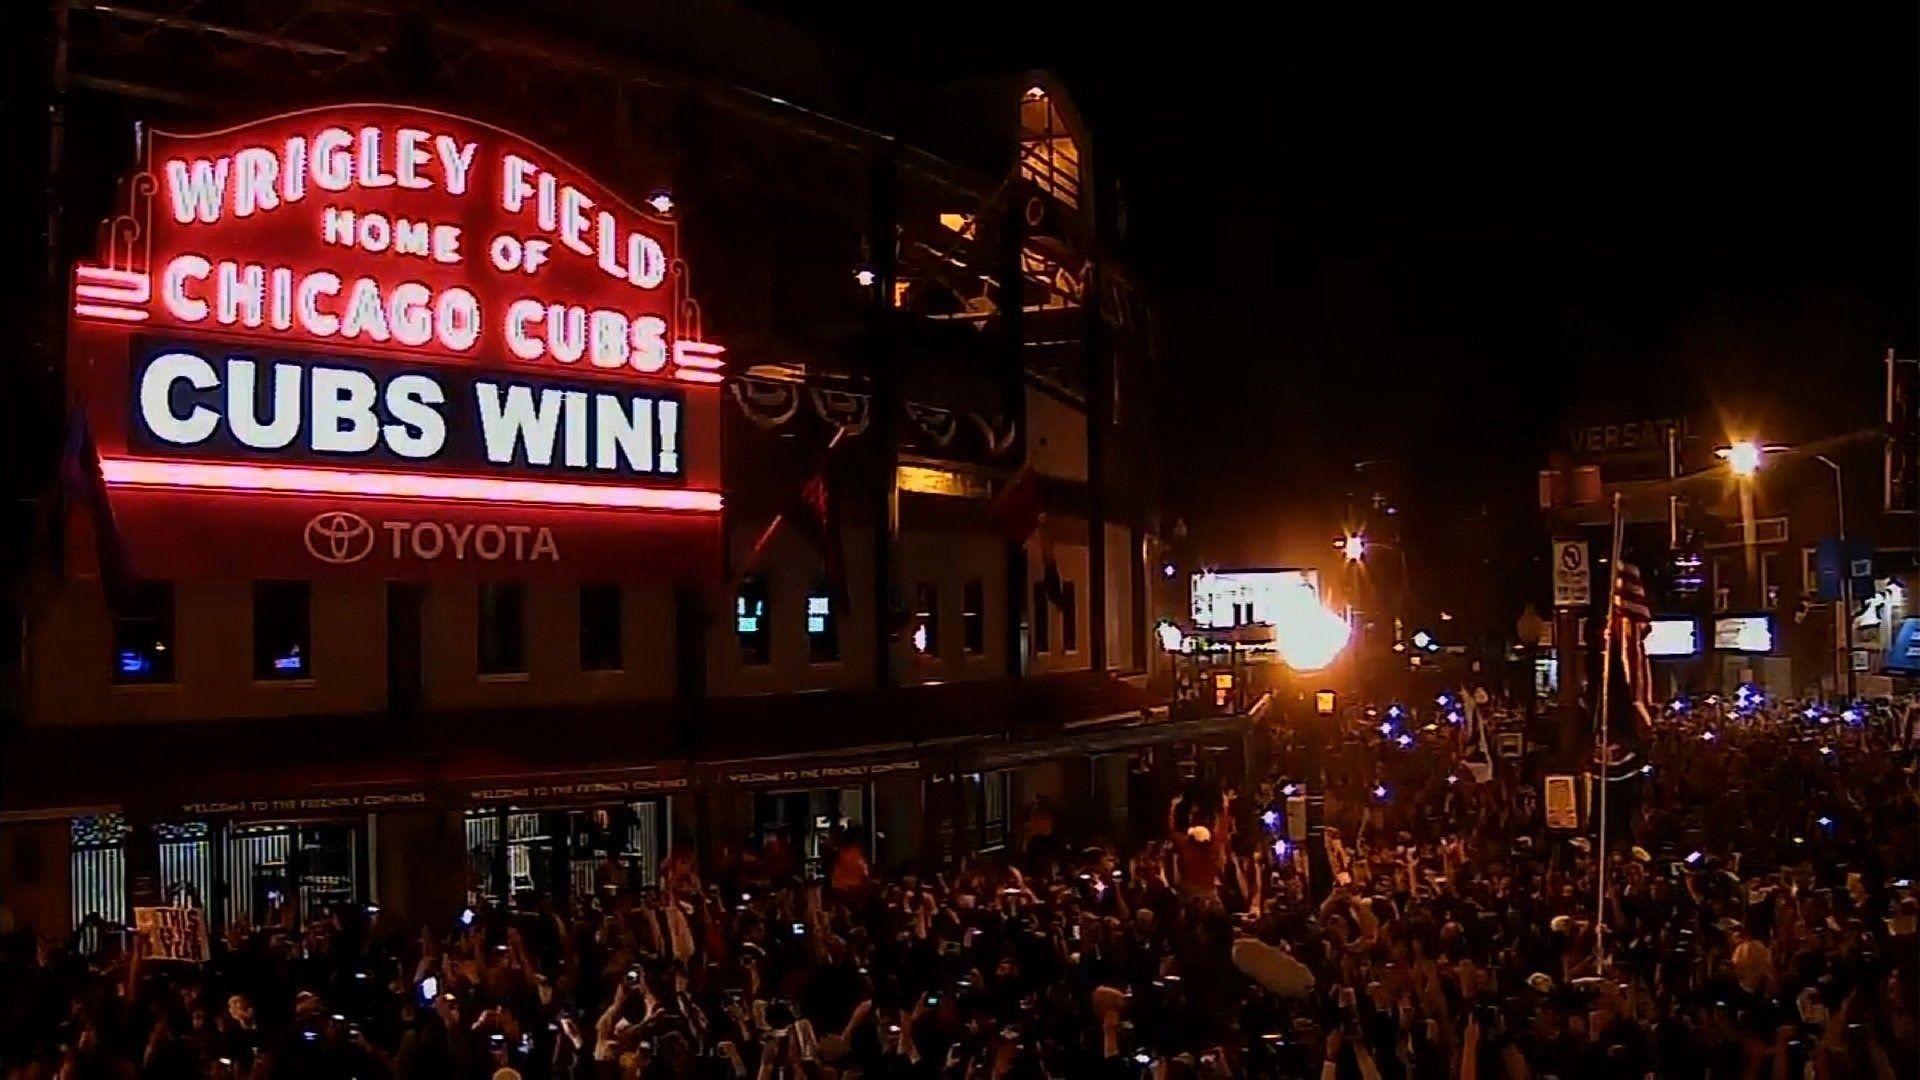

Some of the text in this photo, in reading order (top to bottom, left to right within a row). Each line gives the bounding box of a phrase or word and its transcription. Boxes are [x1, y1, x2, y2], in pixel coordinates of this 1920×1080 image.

[166, 127, 667, 289] WRIGLEY FIELD
[323, 208, 552, 273] HOME OF
[162, 255, 667, 372] CHICAGO CUBS
[139, 353, 680, 473] CUBS WIN!
[383, 521, 560, 562] TOYOTA
